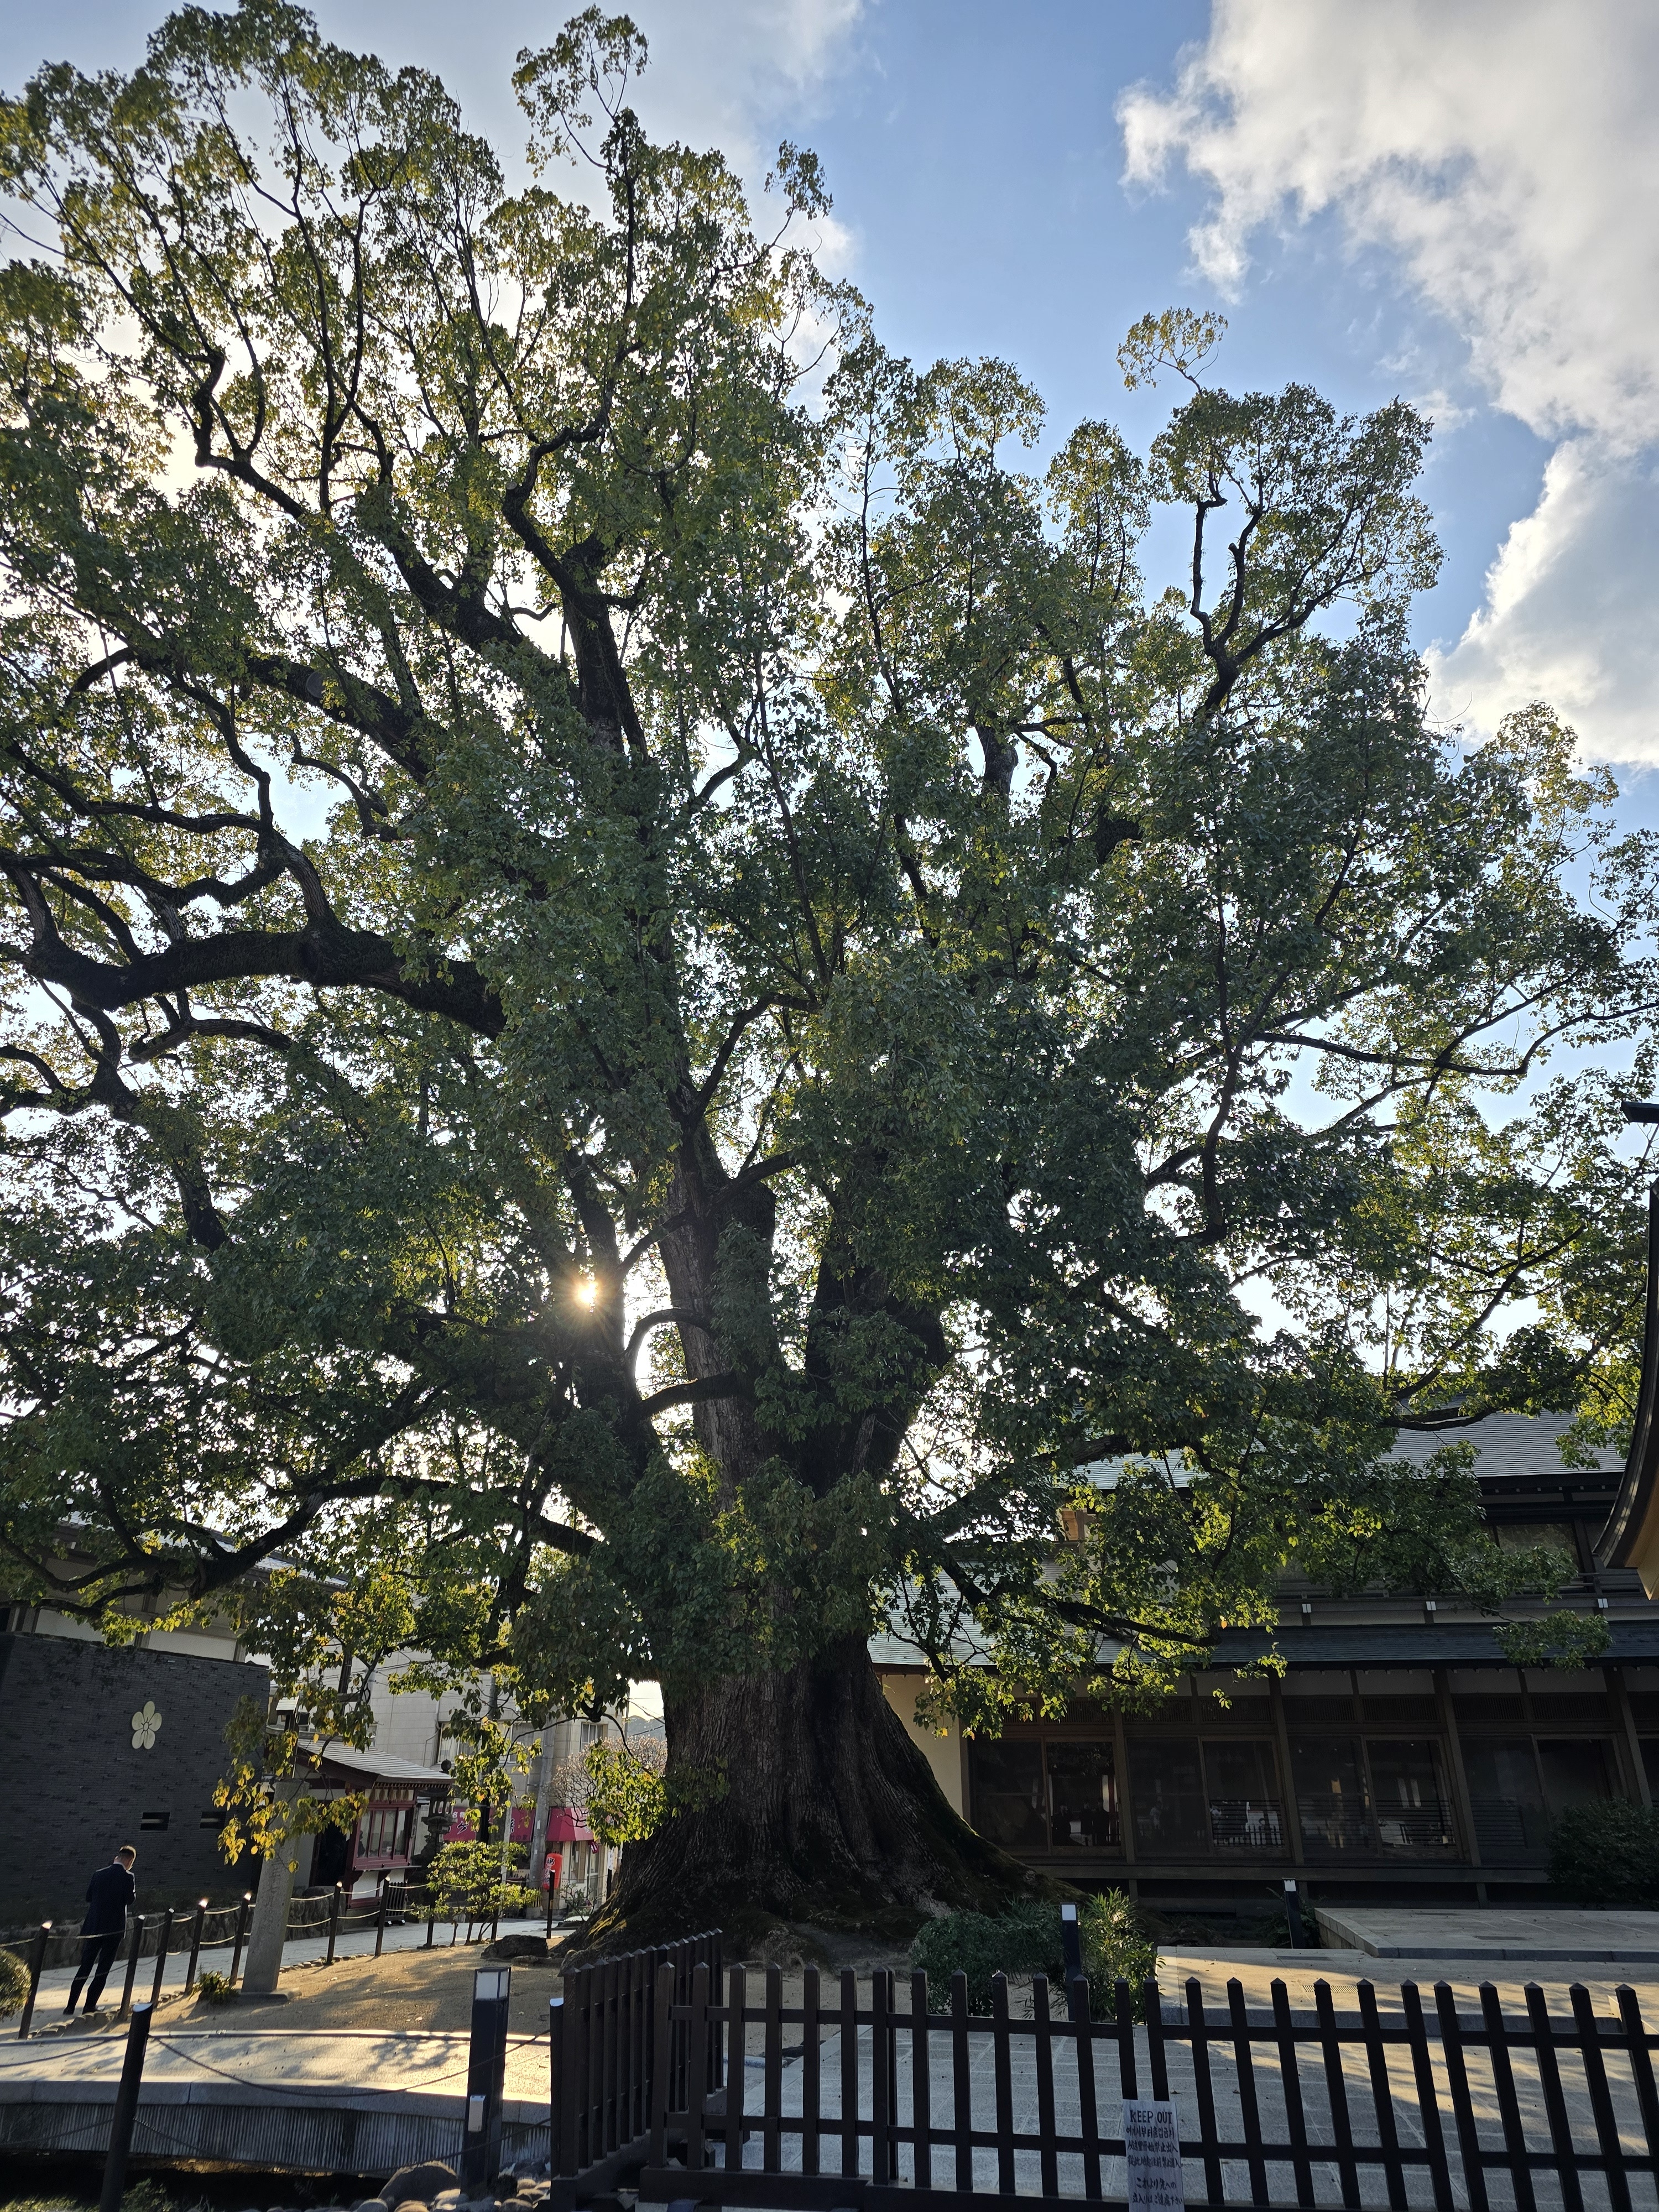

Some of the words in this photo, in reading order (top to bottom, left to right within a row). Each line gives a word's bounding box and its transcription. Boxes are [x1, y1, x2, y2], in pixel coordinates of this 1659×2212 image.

[1130, 2110, 1154, 2123] KEEP
[1157, 2111, 1173, 2124] OUT
[1136, 2177, 1177, 2190] これより先への
